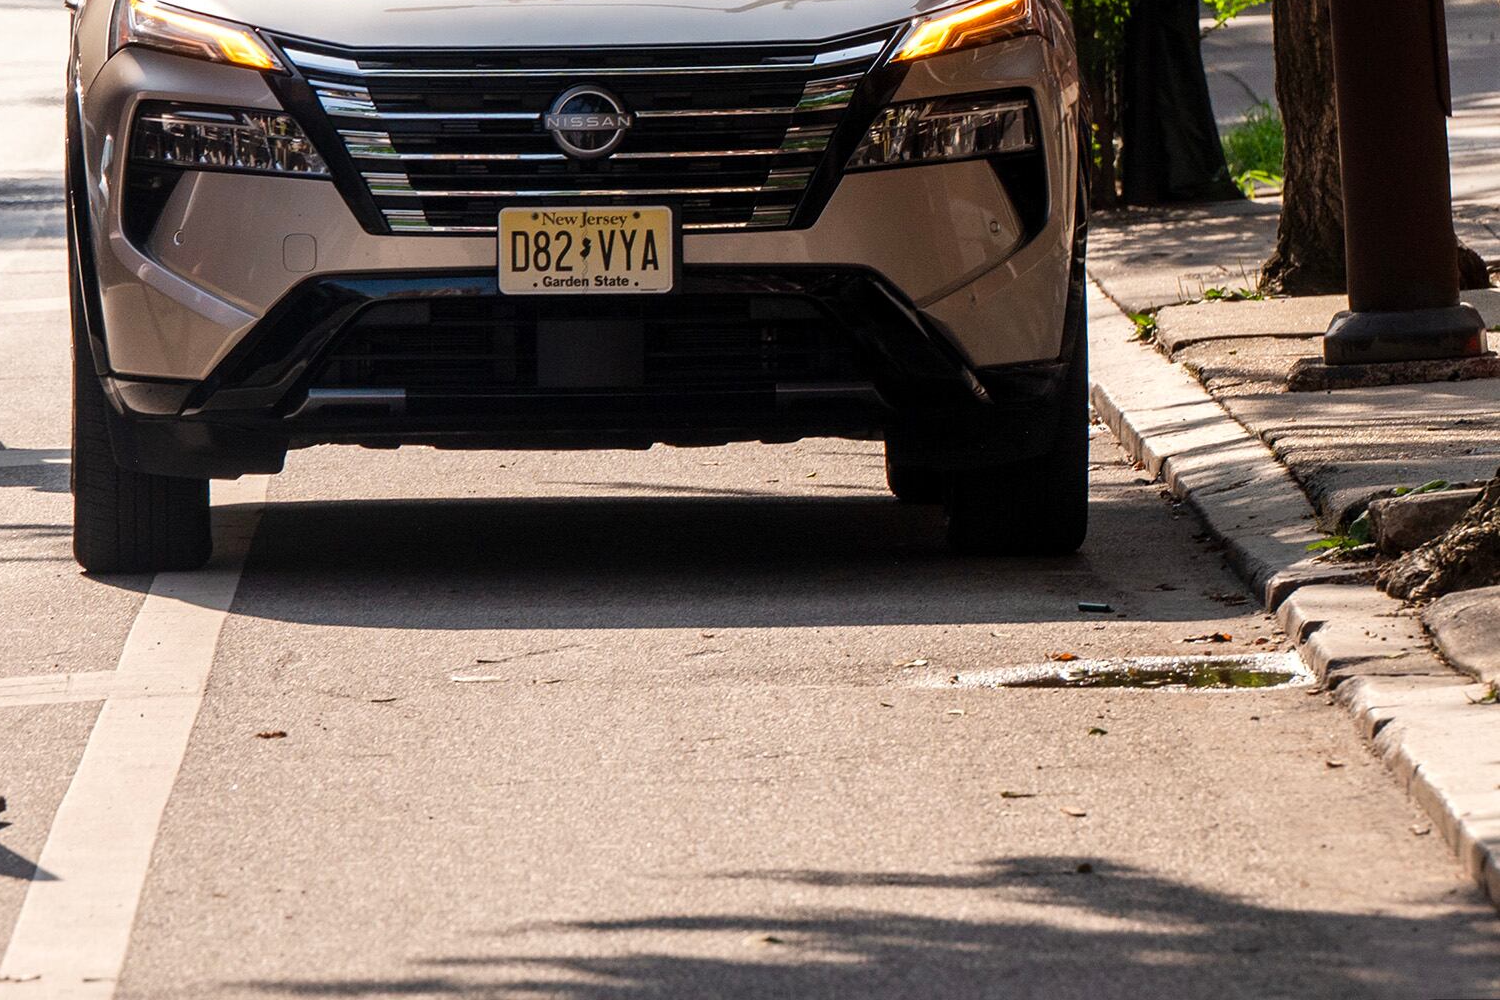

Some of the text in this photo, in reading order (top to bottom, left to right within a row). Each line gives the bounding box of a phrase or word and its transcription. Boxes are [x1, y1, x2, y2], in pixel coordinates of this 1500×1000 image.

[547, 116, 631, 127] NISSAN
[541, 212, 628, 227] New Jersey
[511, 229, 659, 272] D82 VYA
[543, 275, 629, 288] Garden State
